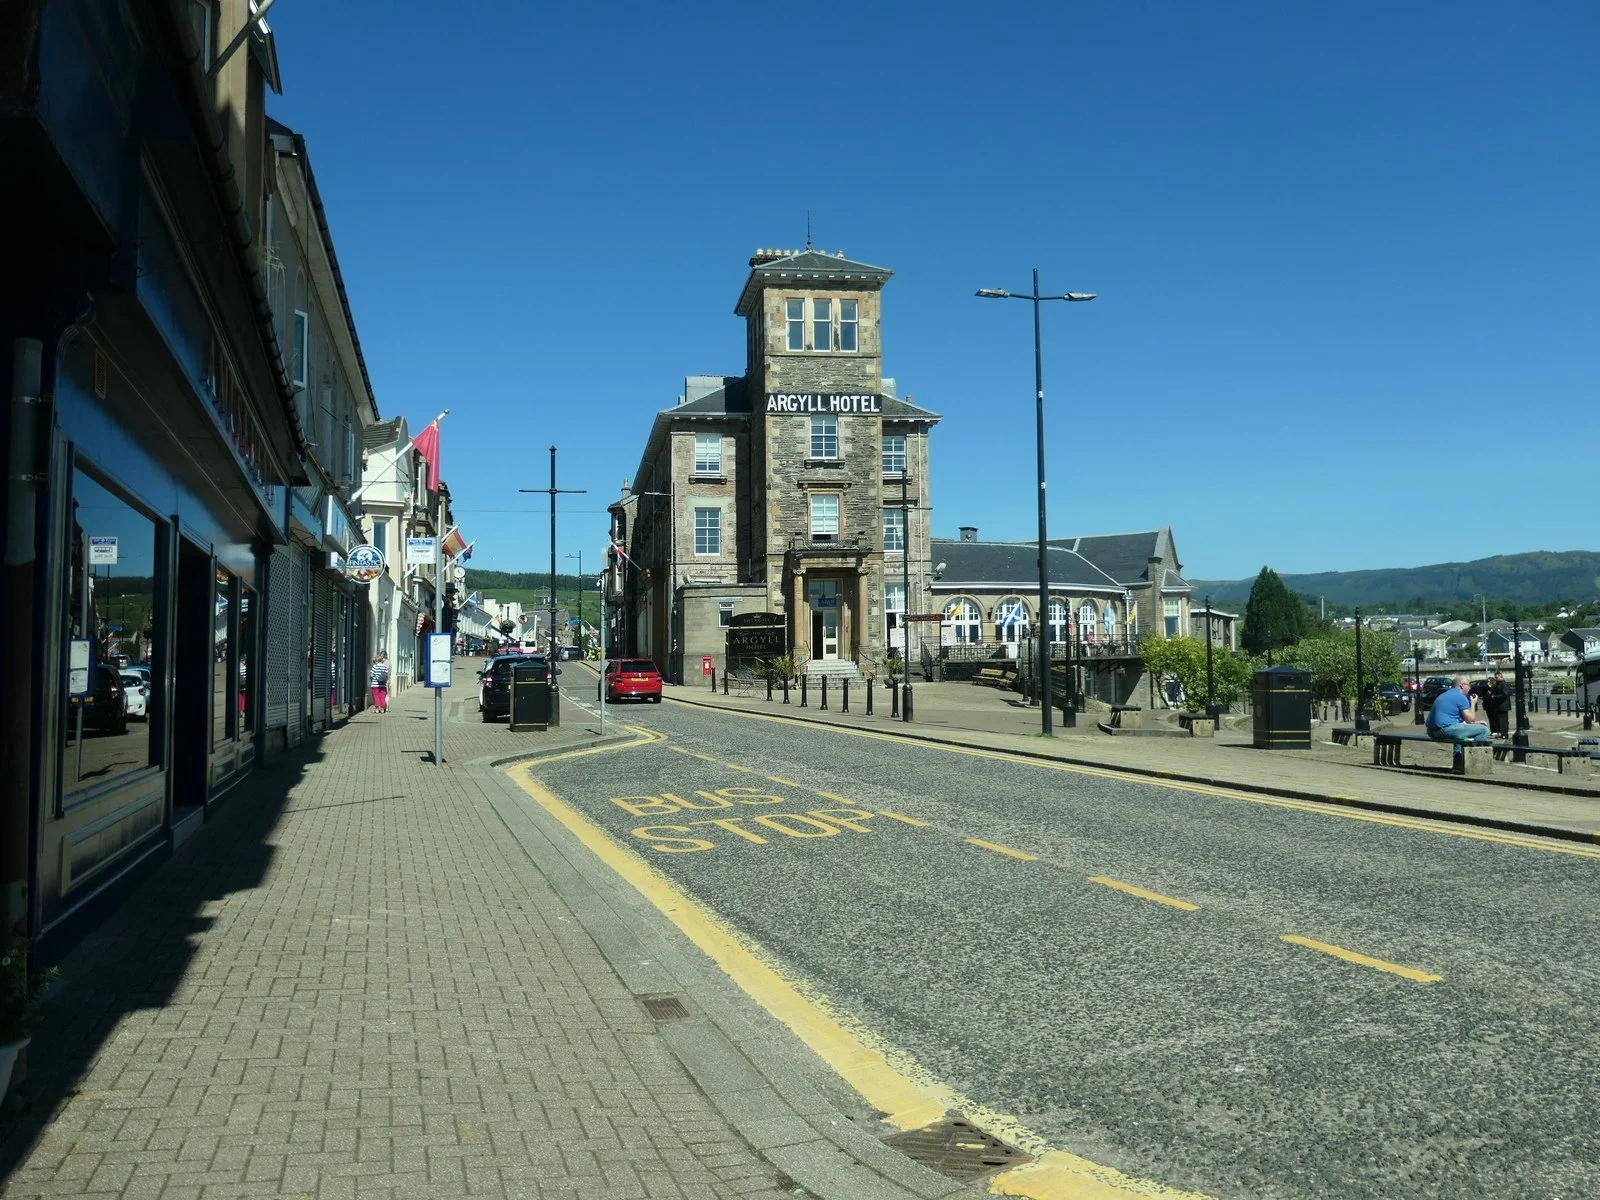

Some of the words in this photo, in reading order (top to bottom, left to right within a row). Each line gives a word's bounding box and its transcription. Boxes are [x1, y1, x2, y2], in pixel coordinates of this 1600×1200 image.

[766, 394, 826, 412] ARGYLL
[829, 395, 880, 412] HOTEL
[732, 635, 781, 645] ARGYLL
[609, 787, 785, 817] BUS
[630, 808, 875, 853] STOP
